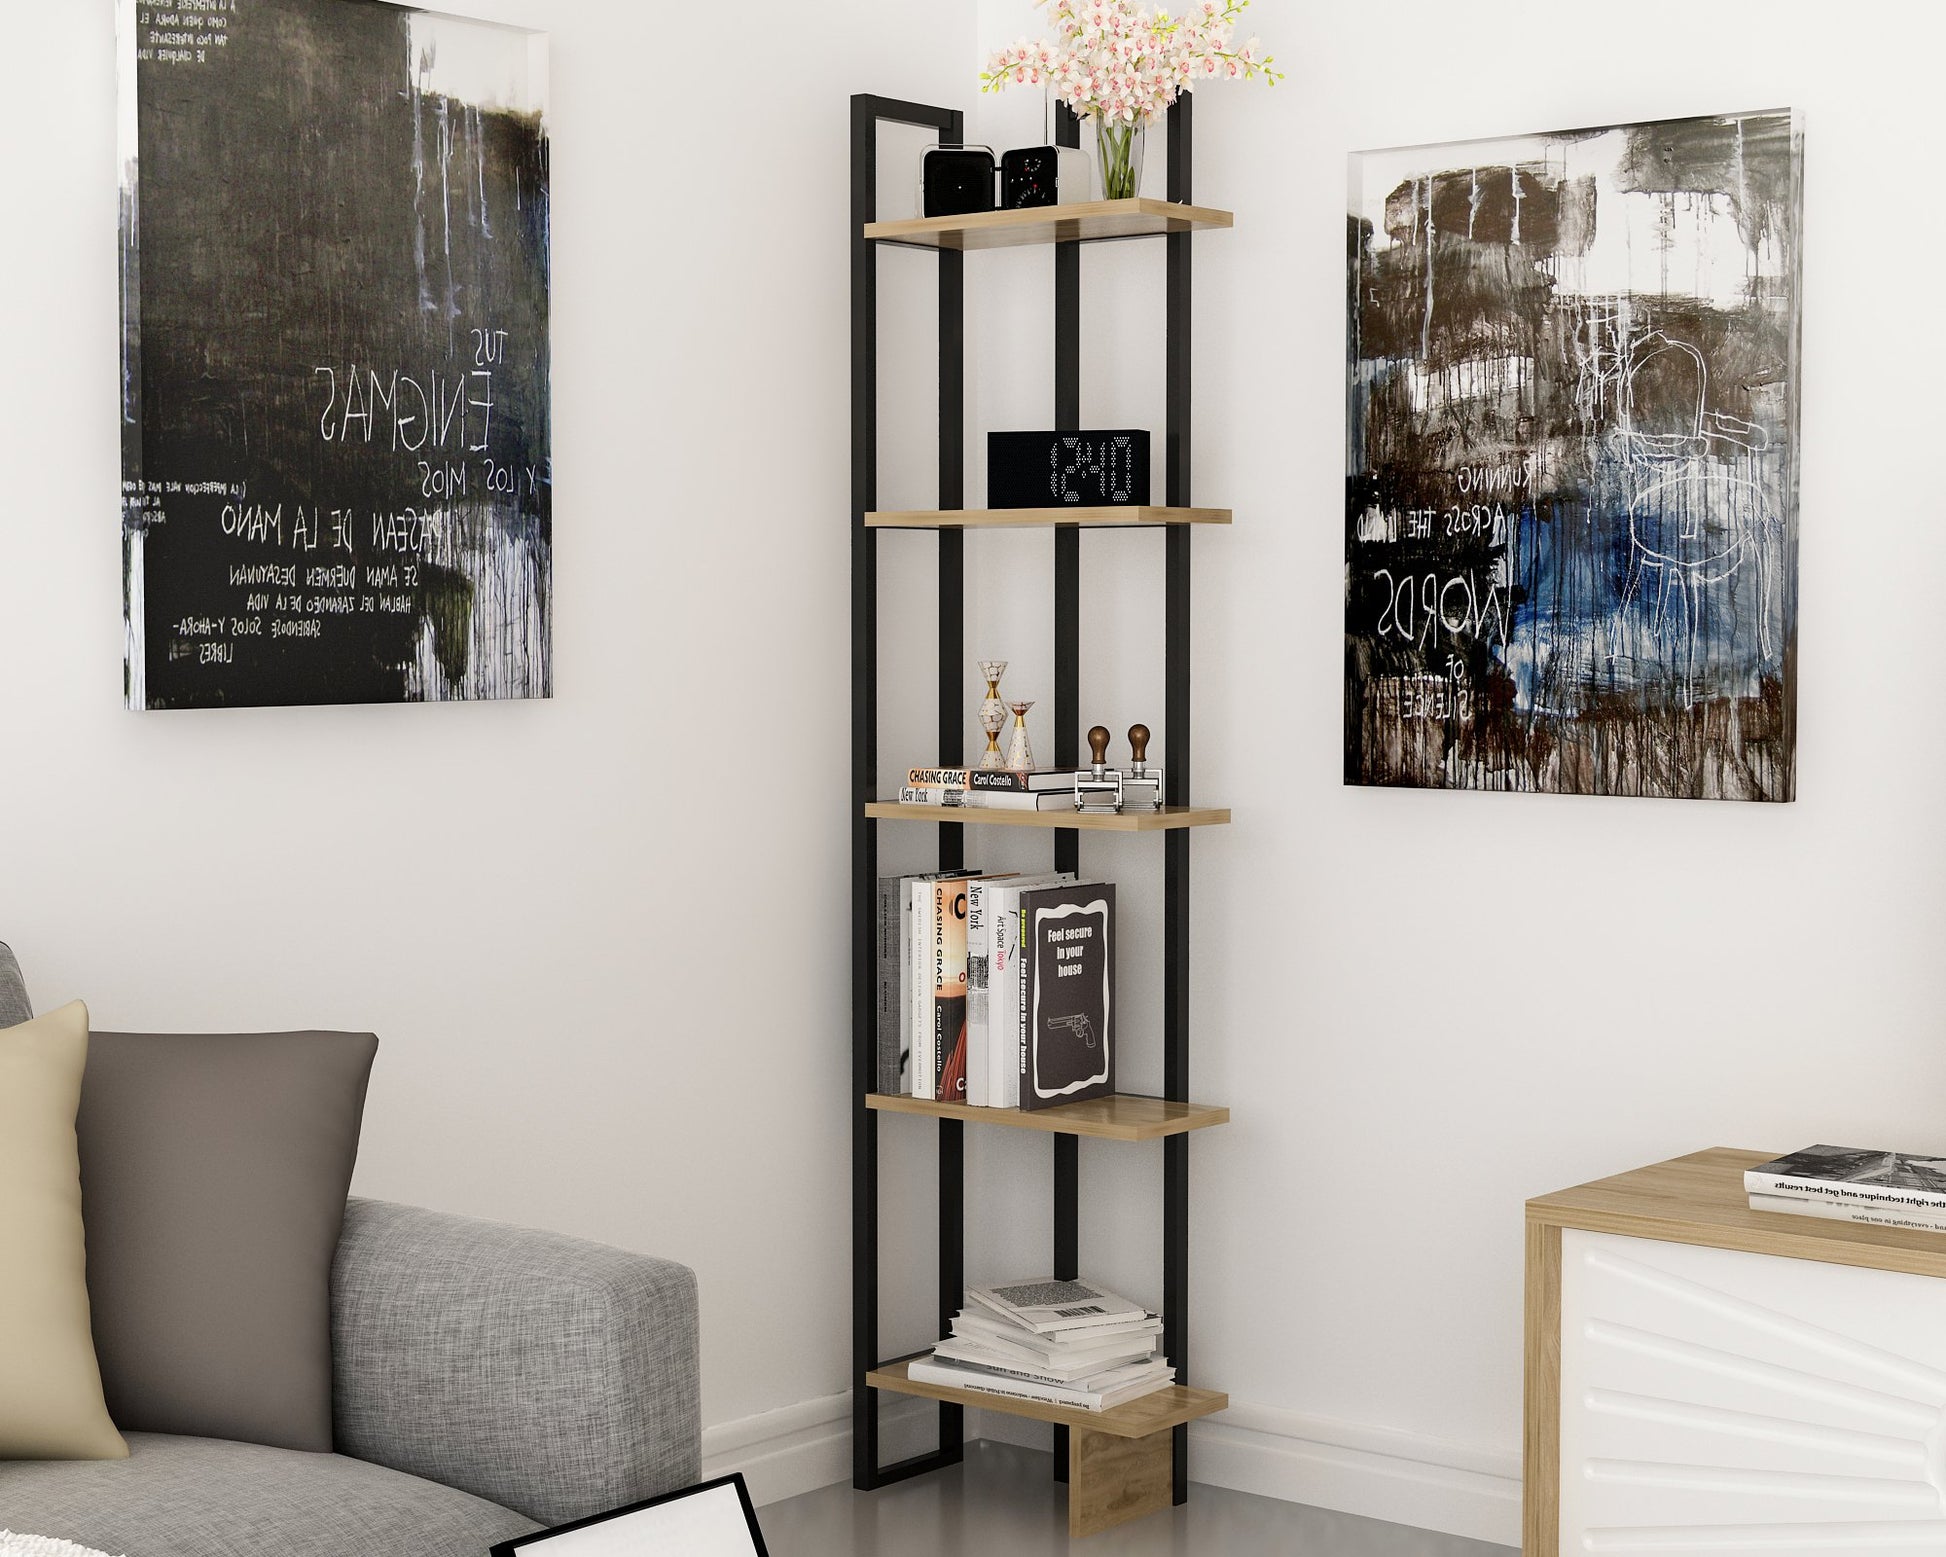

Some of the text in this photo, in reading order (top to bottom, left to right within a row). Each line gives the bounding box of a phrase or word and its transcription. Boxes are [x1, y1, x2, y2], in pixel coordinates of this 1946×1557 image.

[909, 770, 966, 785] CHASING GRACE
[973, 773, 1012, 787] Carol Costello
[901, 787, 928, 803] New York
[970, 886, 983, 907] New
[970, 909, 985, 931] York
[996, 927, 1005, 949] Space
[1047, 926, 1093, 943] Feel secure
[995, 949, 1006, 971] Tokyo
[1056, 945, 1084, 960] in your
[1058, 963, 1083, 978] house
